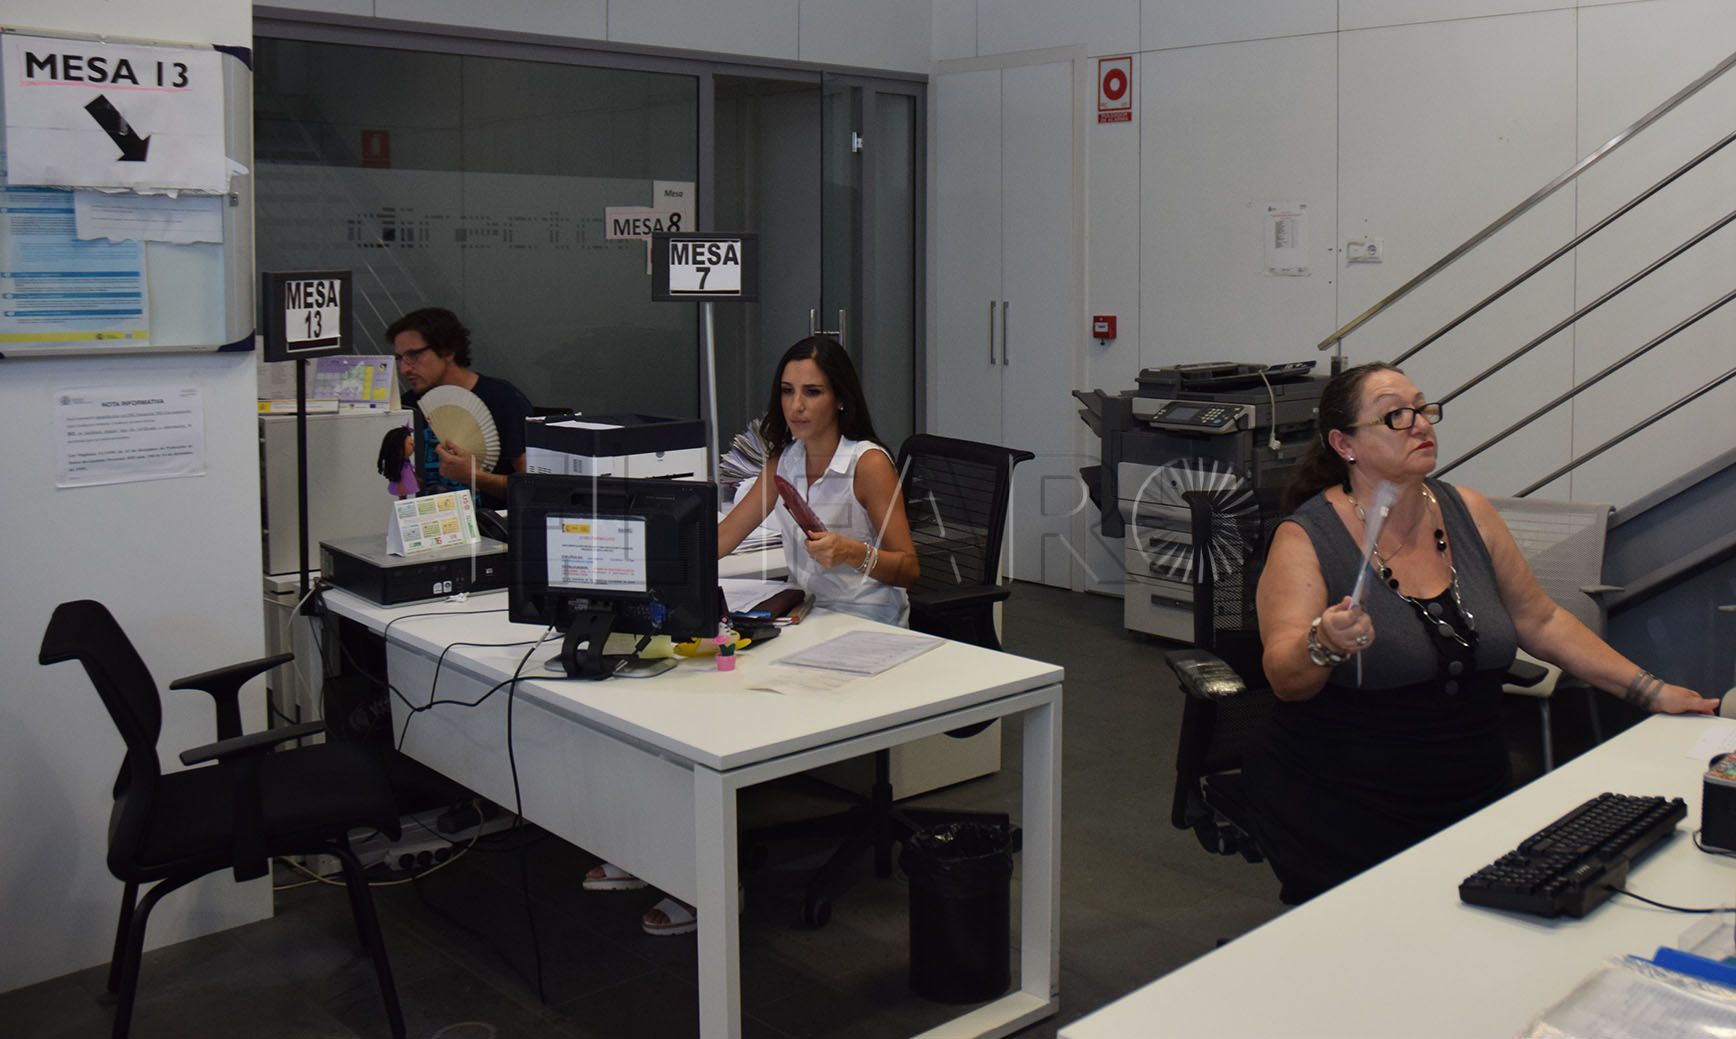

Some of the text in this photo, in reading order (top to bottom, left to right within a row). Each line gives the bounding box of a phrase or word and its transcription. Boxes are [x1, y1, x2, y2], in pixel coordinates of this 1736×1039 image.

[25, 51, 189, 88] MESA 13
[664, 189, 684, 198] Mesa
[613, 217, 664, 236] MESA
[667, 212, 682, 232] 8
[671, 243, 739, 266] MESA
[695, 266, 711, 290] 7
[286, 281, 338, 310] MESA
[304, 310, 322, 339] 13
